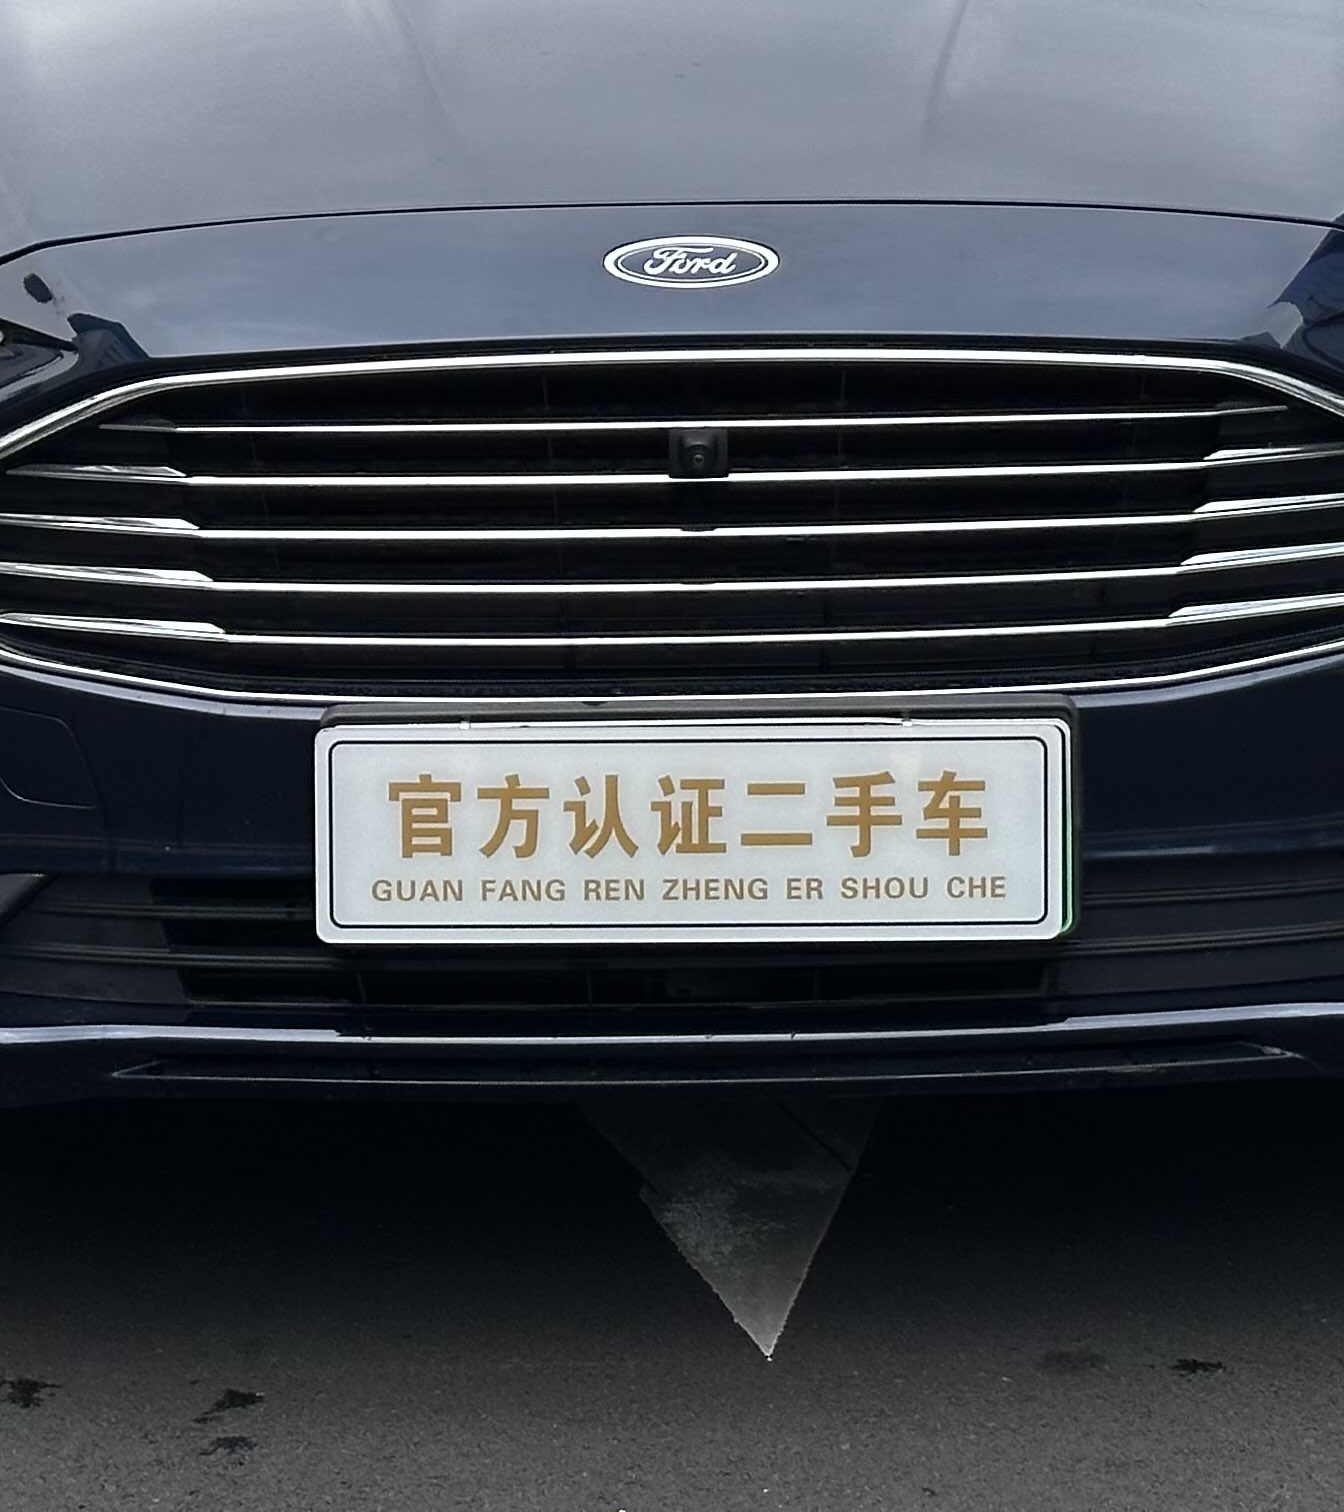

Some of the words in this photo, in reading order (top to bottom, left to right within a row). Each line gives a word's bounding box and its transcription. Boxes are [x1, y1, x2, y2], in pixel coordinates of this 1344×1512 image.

[643, 246, 738, 275] Ford
[387, 770, 989, 859] 官方认证二手车
[370, 878, 464, 903] GUAN
[480, 878, 567, 903] FANG
[583, 878, 646, 902] REN
[661, 877, 769, 902] ZHENG
[785, 877, 824, 901] ER
[840, 876, 929, 900] SHOU
[946, 875, 1007, 900] CHE
